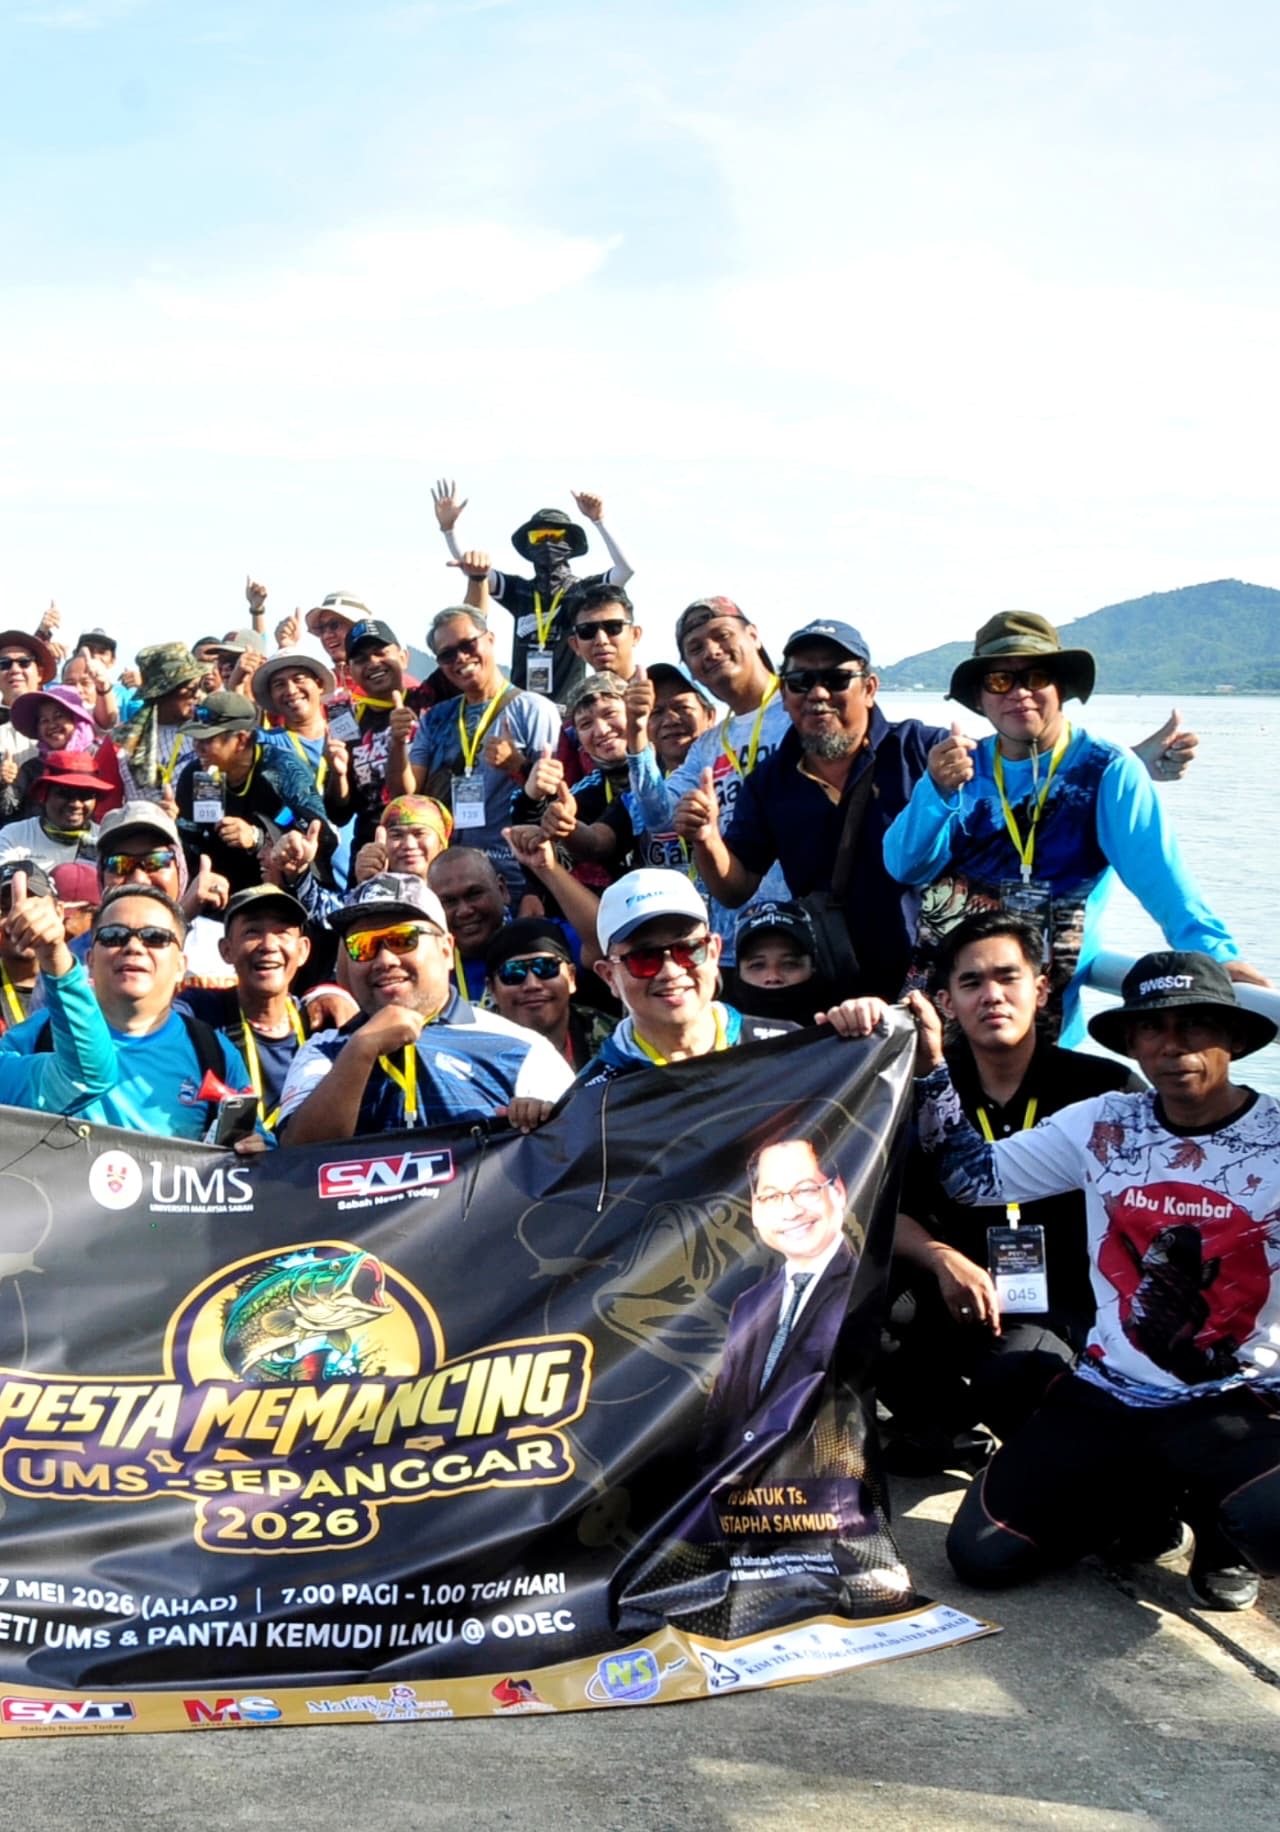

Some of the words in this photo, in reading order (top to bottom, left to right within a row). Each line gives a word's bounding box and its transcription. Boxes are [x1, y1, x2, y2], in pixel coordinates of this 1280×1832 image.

[150, 1161, 254, 1204] UMS
[337, 1197, 373, 1210] Sabah
[375, 1192, 405, 1206] News
[406, 1187, 441, 1200] Today
[1124, 1188, 1159, 1211] Abu
[1163, 1196, 1233, 1219] Kombat
[1007, 1287, 1037, 1301] 045
[183, 1350, 572, 1456] MEMANCING
[786, 1487, 807, 1505] Ts.
[217, 1507, 360, 1541] 2026
[15, 1579, 65, 1604] MEI
[71, 1586, 135, 1616] 2026
[141, 1594, 238, 1621] (AHAD)
[281, 1585, 336, 1605] 7.00
[341, 1584, 398, 1605] PAGI
[421, 1584, 466, 1606] 1.00
[470, 1580, 512, 1602] TGH
[513, 1572, 567, 1597] HARI
[45, 1621, 111, 1650] UMS
[119, 1628, 139, 1646] &
[148, 1622, 257, 1648] PANTAI
[266, 1622, 382, 1649] KEMUDI
[388, 1619, 454, 1647] ILMU
[461, 1617, 485, 1645] @
[491, 1609, 576, 1640] ODEC
[606, 1655, 653, 1687] NS
[183, 1696, 283, 1723] MS
